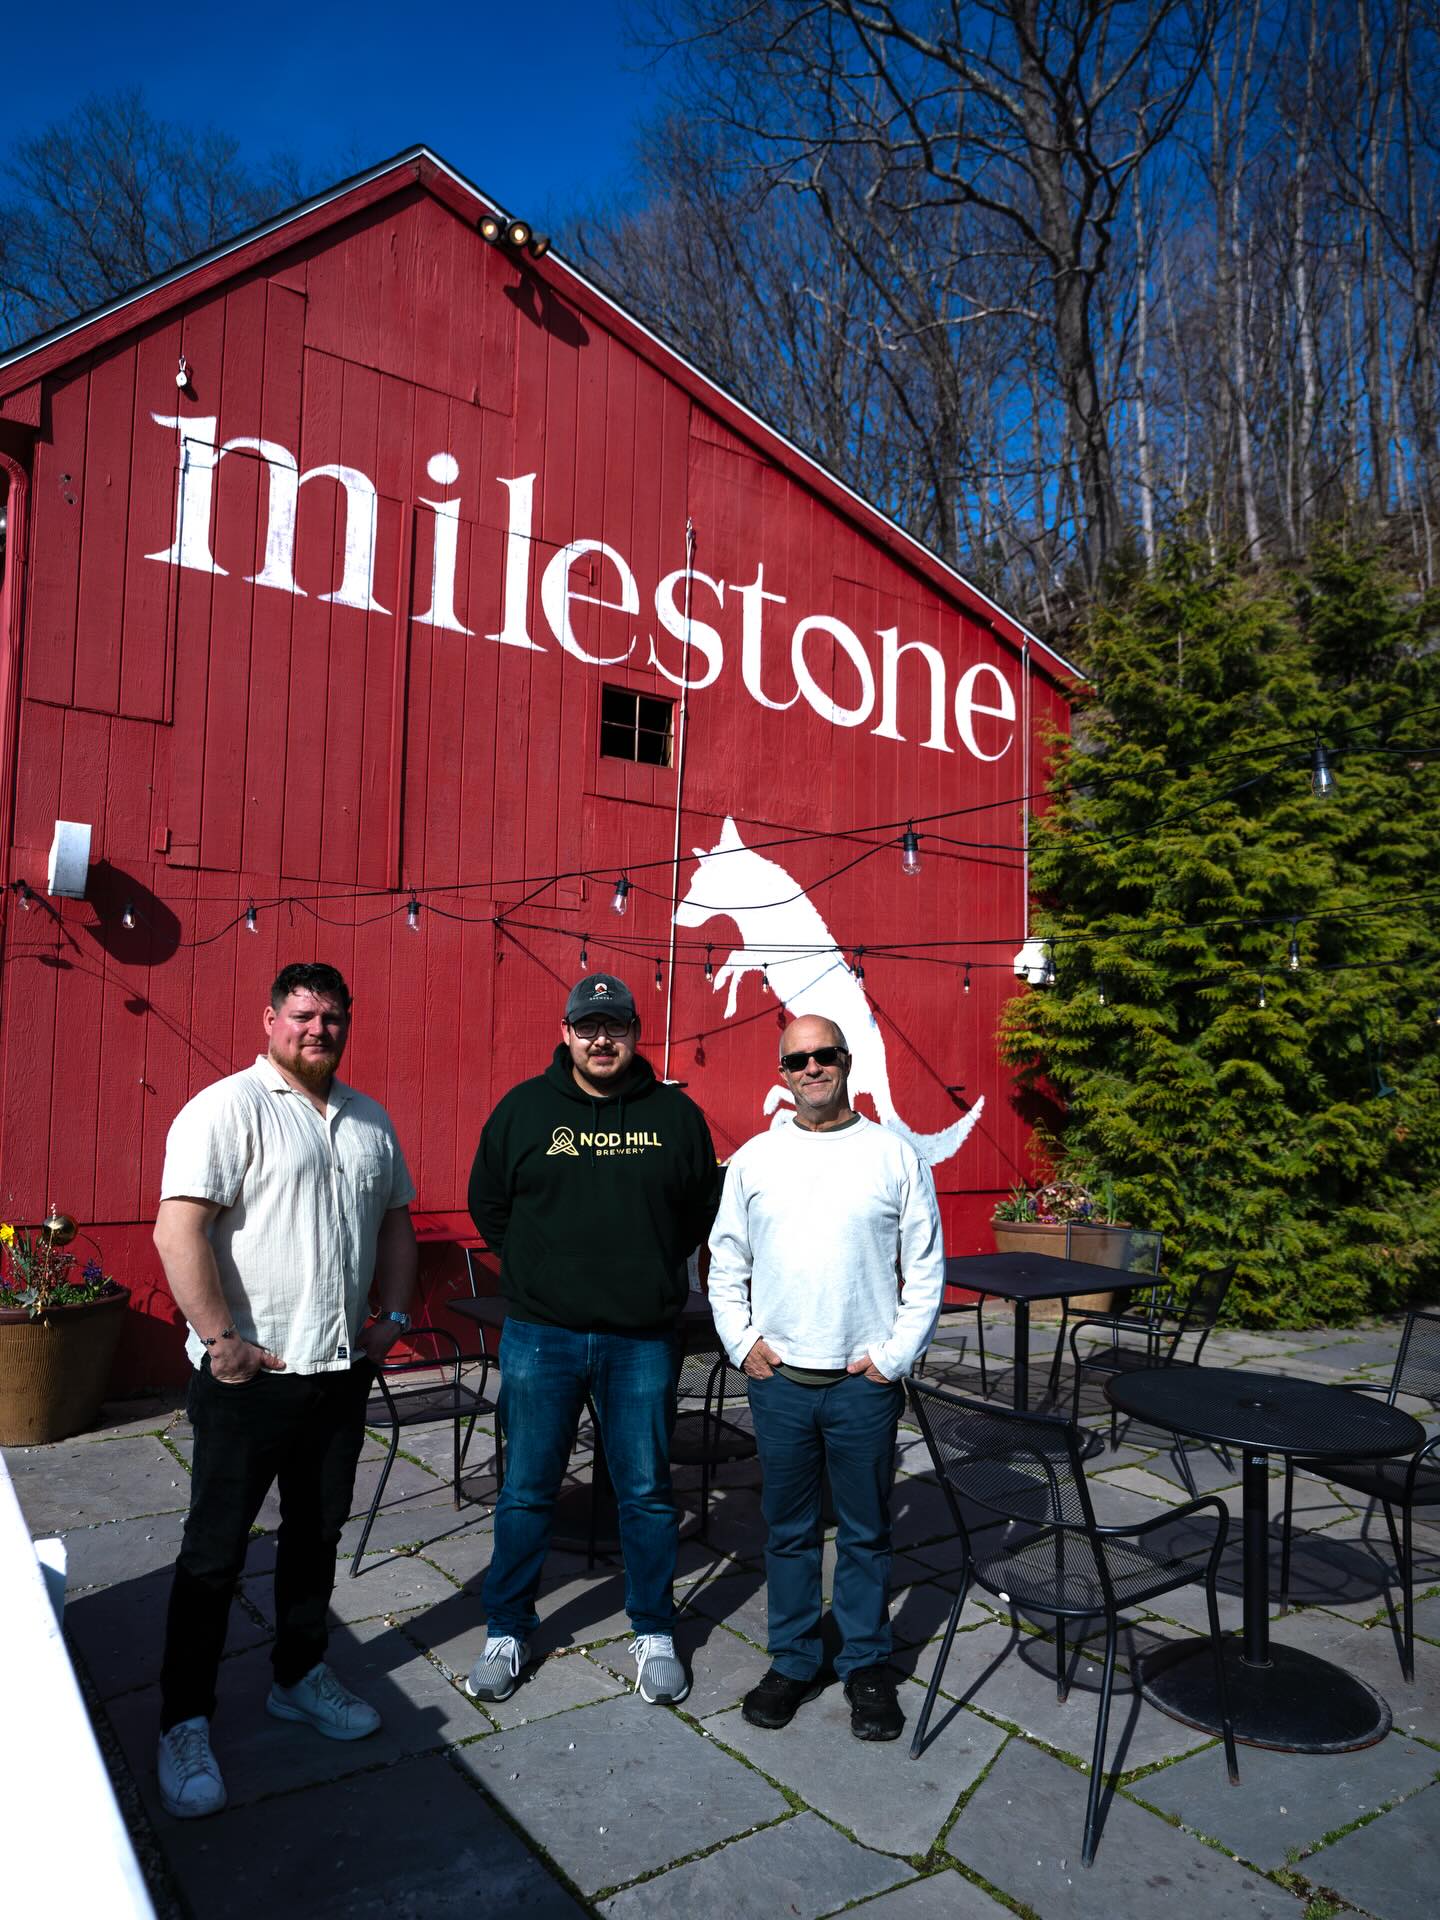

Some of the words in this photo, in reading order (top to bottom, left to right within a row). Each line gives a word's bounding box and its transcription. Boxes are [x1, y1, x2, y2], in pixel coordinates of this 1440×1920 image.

[144, 411, 1016, 762] milestone
[580, 1132, 621, 1147] NOD
[625, 1131, 663, 1147] HILL
[595, 1147, 645, 1156] BREWERY
